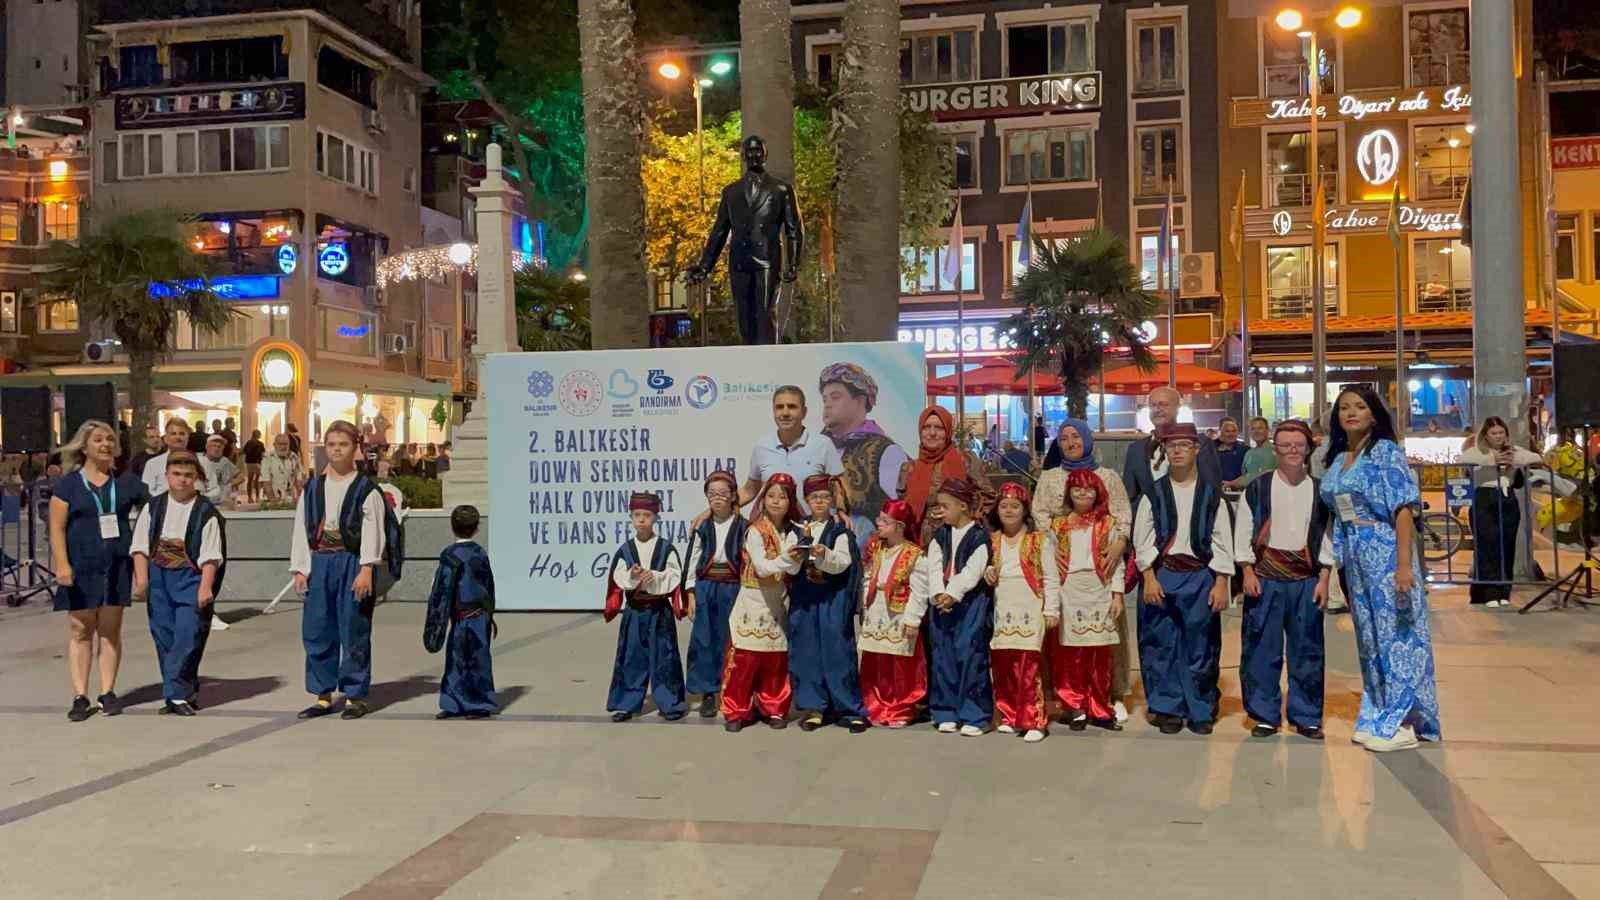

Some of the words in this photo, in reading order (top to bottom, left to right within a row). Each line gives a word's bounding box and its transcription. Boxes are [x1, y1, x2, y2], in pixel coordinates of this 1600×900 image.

[1019, 77, 1097, 105] KING
[1554, 144, 1600, 163] KENT
[529, 430, 546, 453] 2.
[555, 426, 650, 452] BALIKESİR
[529, 460, 581, 483] DOWN
[529, 491, 574, 514] HALK
[583, 489, 674, 513] OYUNRI
[529, 522, 549, 544] VE
[559, 521, 606, 544] DANS
[529, 554, 577, 583] Hoş
